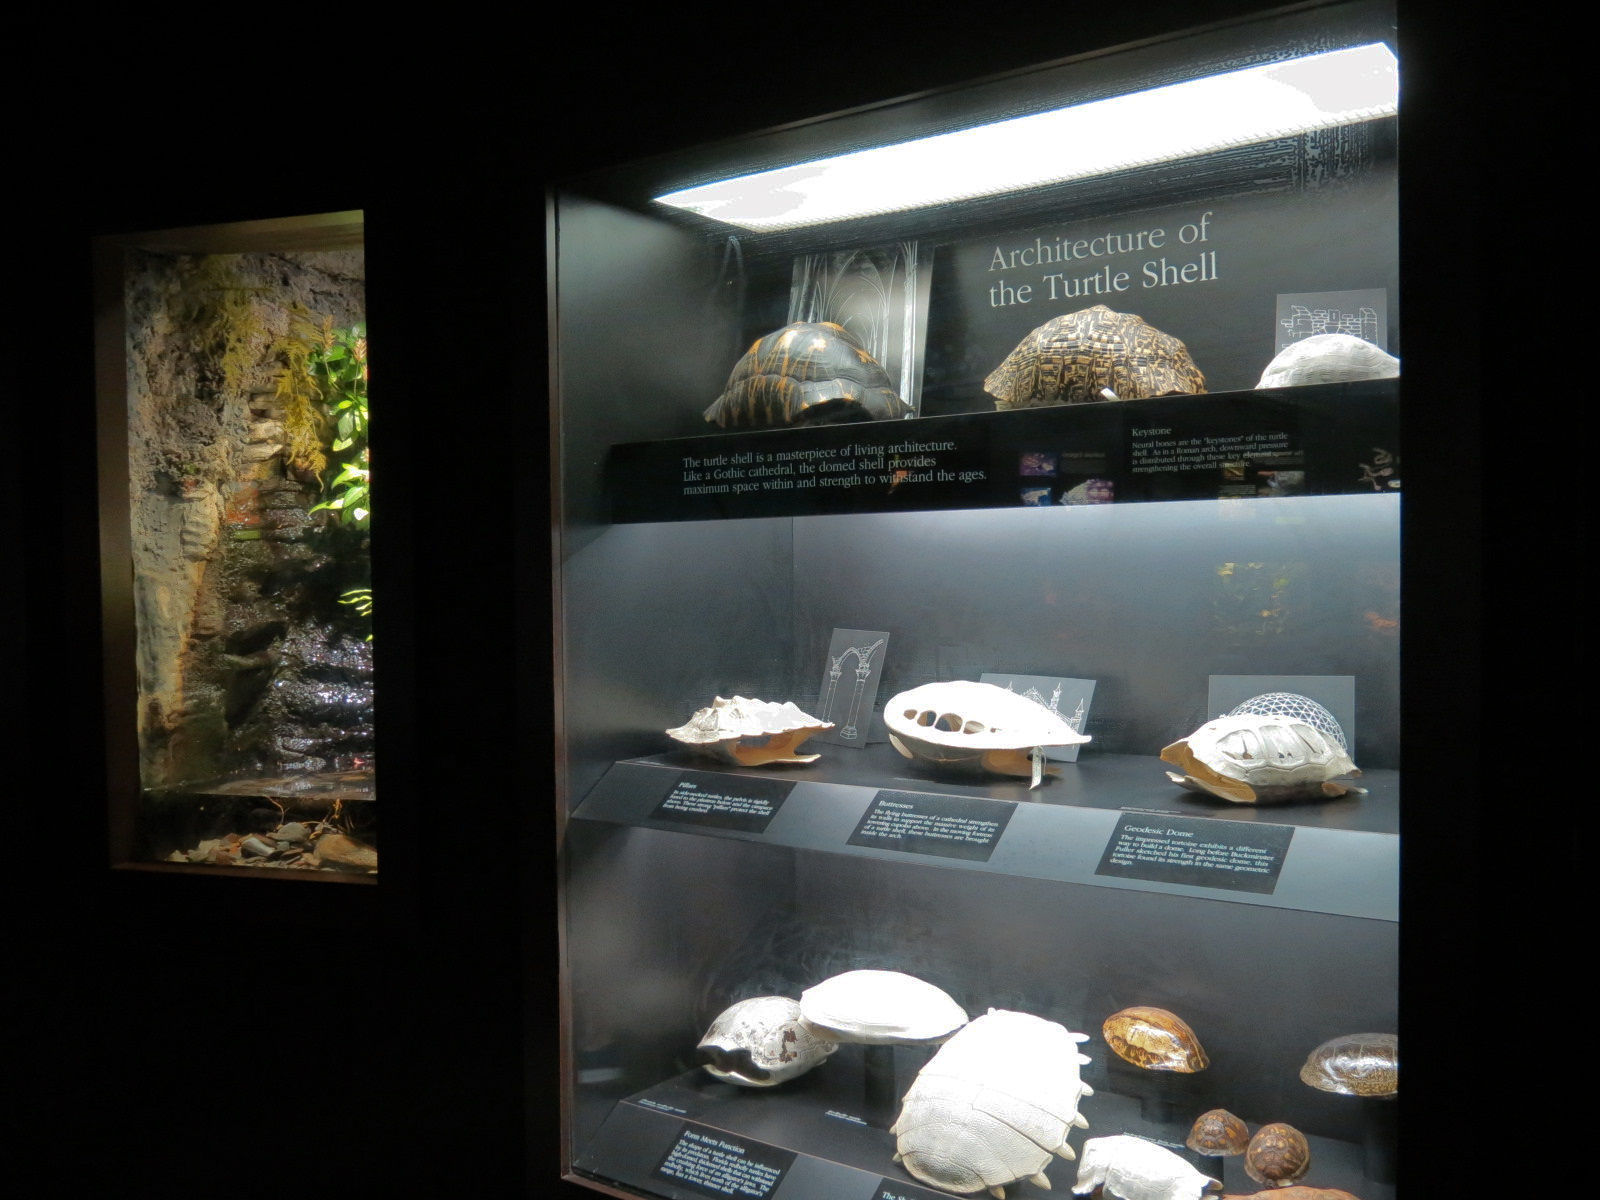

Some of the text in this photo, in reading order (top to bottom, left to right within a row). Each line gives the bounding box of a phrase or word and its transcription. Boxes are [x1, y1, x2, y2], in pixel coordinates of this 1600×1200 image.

[988, 212, 1212, 272] Architecture of
[990, 251, 1218, 308] the Turtle Shell
[1132, 428, 1172, 438] Keystone
[1132, 440, 1154, 449] Neural
[1202, 444, 1218, 452] arch,
[1220, 442, 1256, 451] downward
[1259, 443, 1288, 451] pressure
[683, 457, 700, 468] The
[704, 455, 728, 466] turtle
[731, 452, 752, 464] shell
[756, 452, 764, 462] is
[776, 448, 836, 461] masterpiece
[840, 445, 852, 456] of
[855, 444, 884, 457] living
[888, 442, 957, 453] architecture.
[1140, 455, 1176, 464] distributed
[1178, 453, 1204, 463] through
[1228, 452, 1240, 461] key
[684, 470, 702, 481] Like
[714, 467, 745, 479] Gothic
[748, 464, 796, 477] cathedral,
[800, 462, 815, 473] the
[819, 460, 855, 472] domed
[859, 458, 884, 470] shell
[888, 456, 936, 471] provides
[1132, 464, 1178, 474] strengthening
[1193, 461, 1216, 470] overall
[684, 470, 987, 495] maximum space within and strength to withstand the ages.
[879, 800, 914, 809] Buttresses
[1124, 825, 1194, 837] Geodesic Dome
[1135, 836, 1170, 844] impressed
[1230, 852, 1274, 861] Buckminster
[684, 1130, 745, 1154] Form Meets Function
[883, 1191, 896, 1200] The
